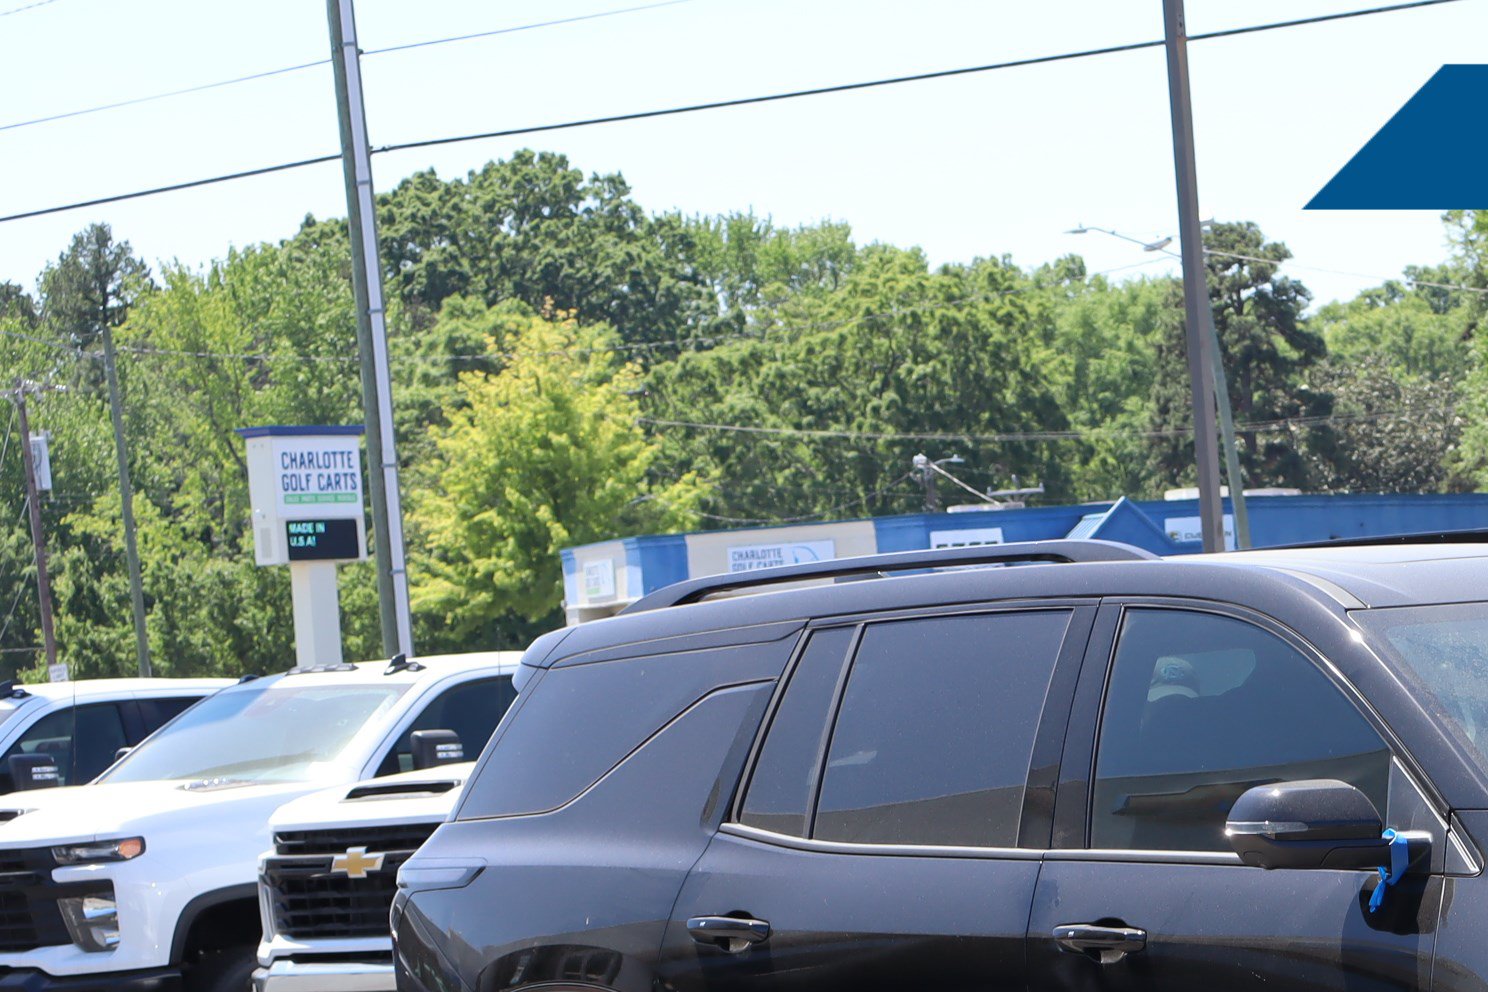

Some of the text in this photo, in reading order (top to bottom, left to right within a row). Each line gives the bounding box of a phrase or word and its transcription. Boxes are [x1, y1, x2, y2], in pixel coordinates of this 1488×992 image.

[281, 451, 354, 469] CHARLOTTE
[281, 472, 357, 491] GOLF CARTS
[288, 522, 326, 533] MADE IN
[731, 547, 782, 561] CHARLOTTE
